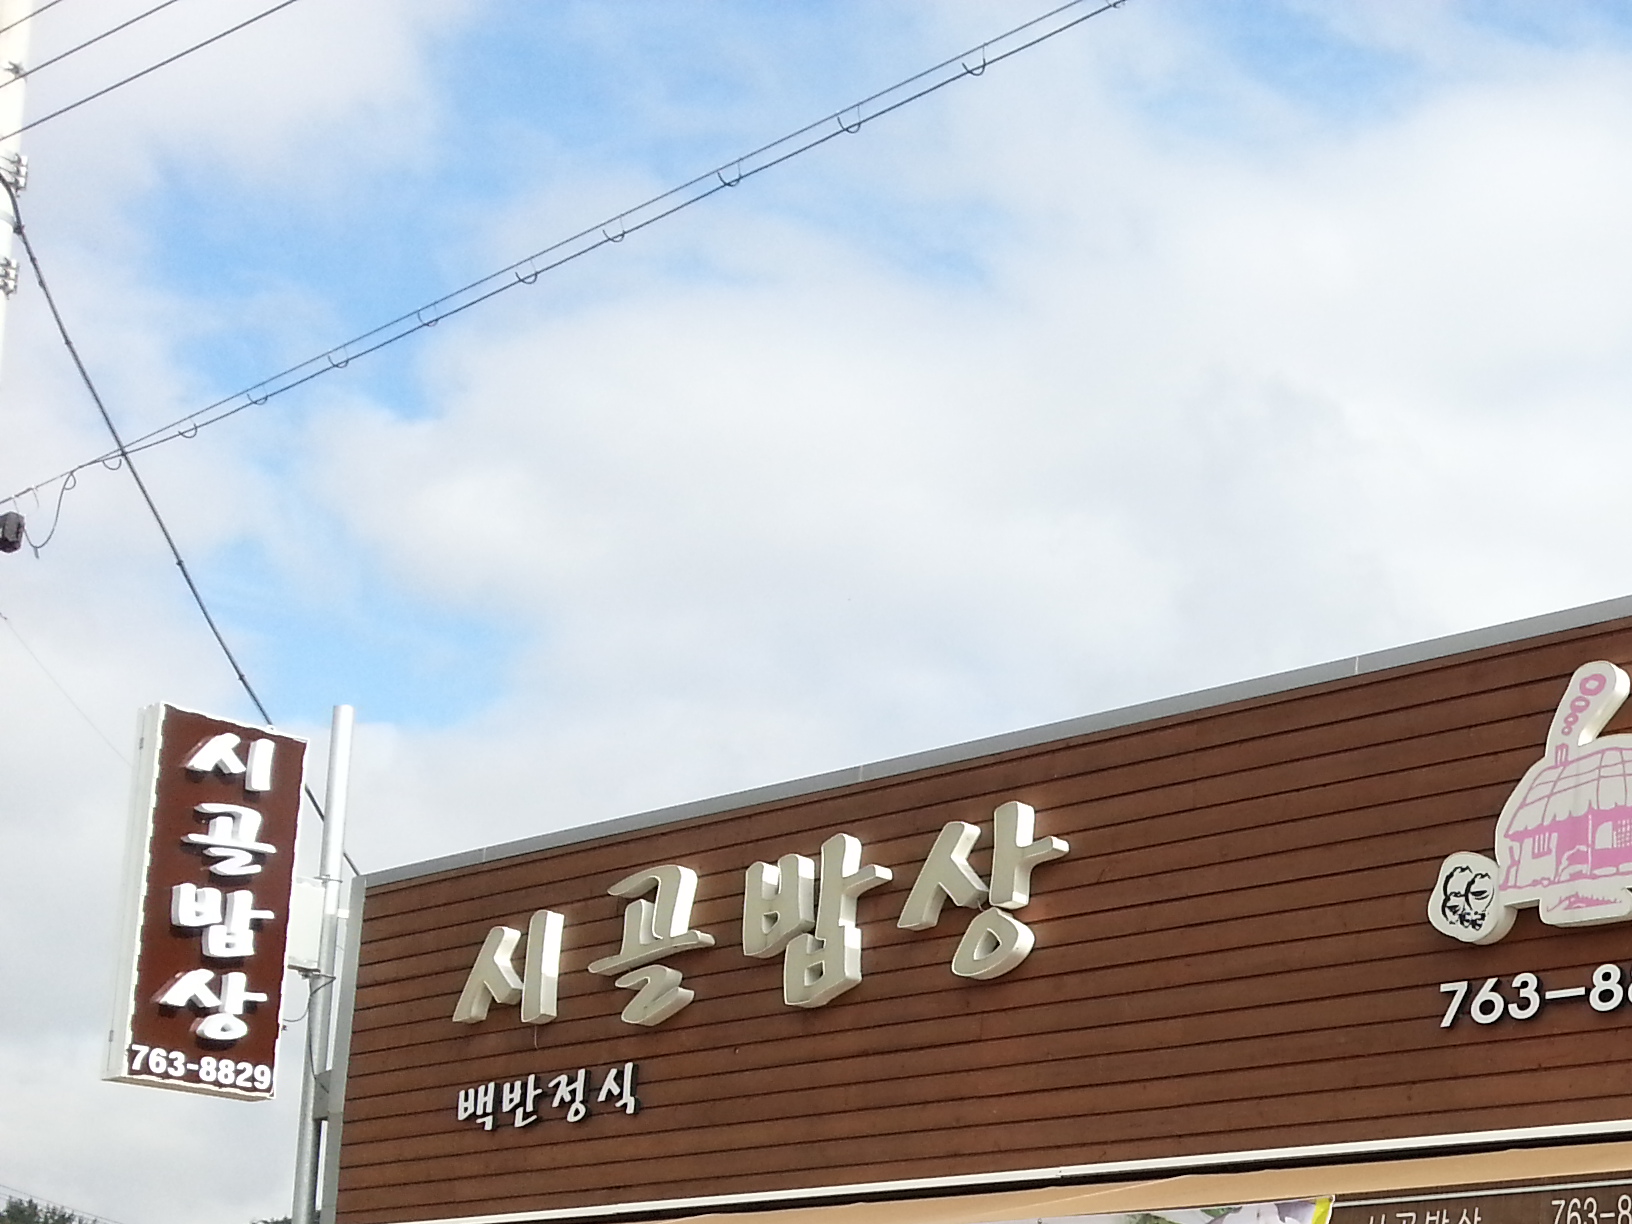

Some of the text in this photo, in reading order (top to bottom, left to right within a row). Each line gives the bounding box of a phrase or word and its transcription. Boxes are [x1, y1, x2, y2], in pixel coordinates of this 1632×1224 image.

[157, 732, 277, 1041] 시골밥상
[452, 801, 1070, 1027] 시골밥상
[130, 1043, 274, 1090] 763-8829
[457, 1062, 637, 1131] 백반정식
